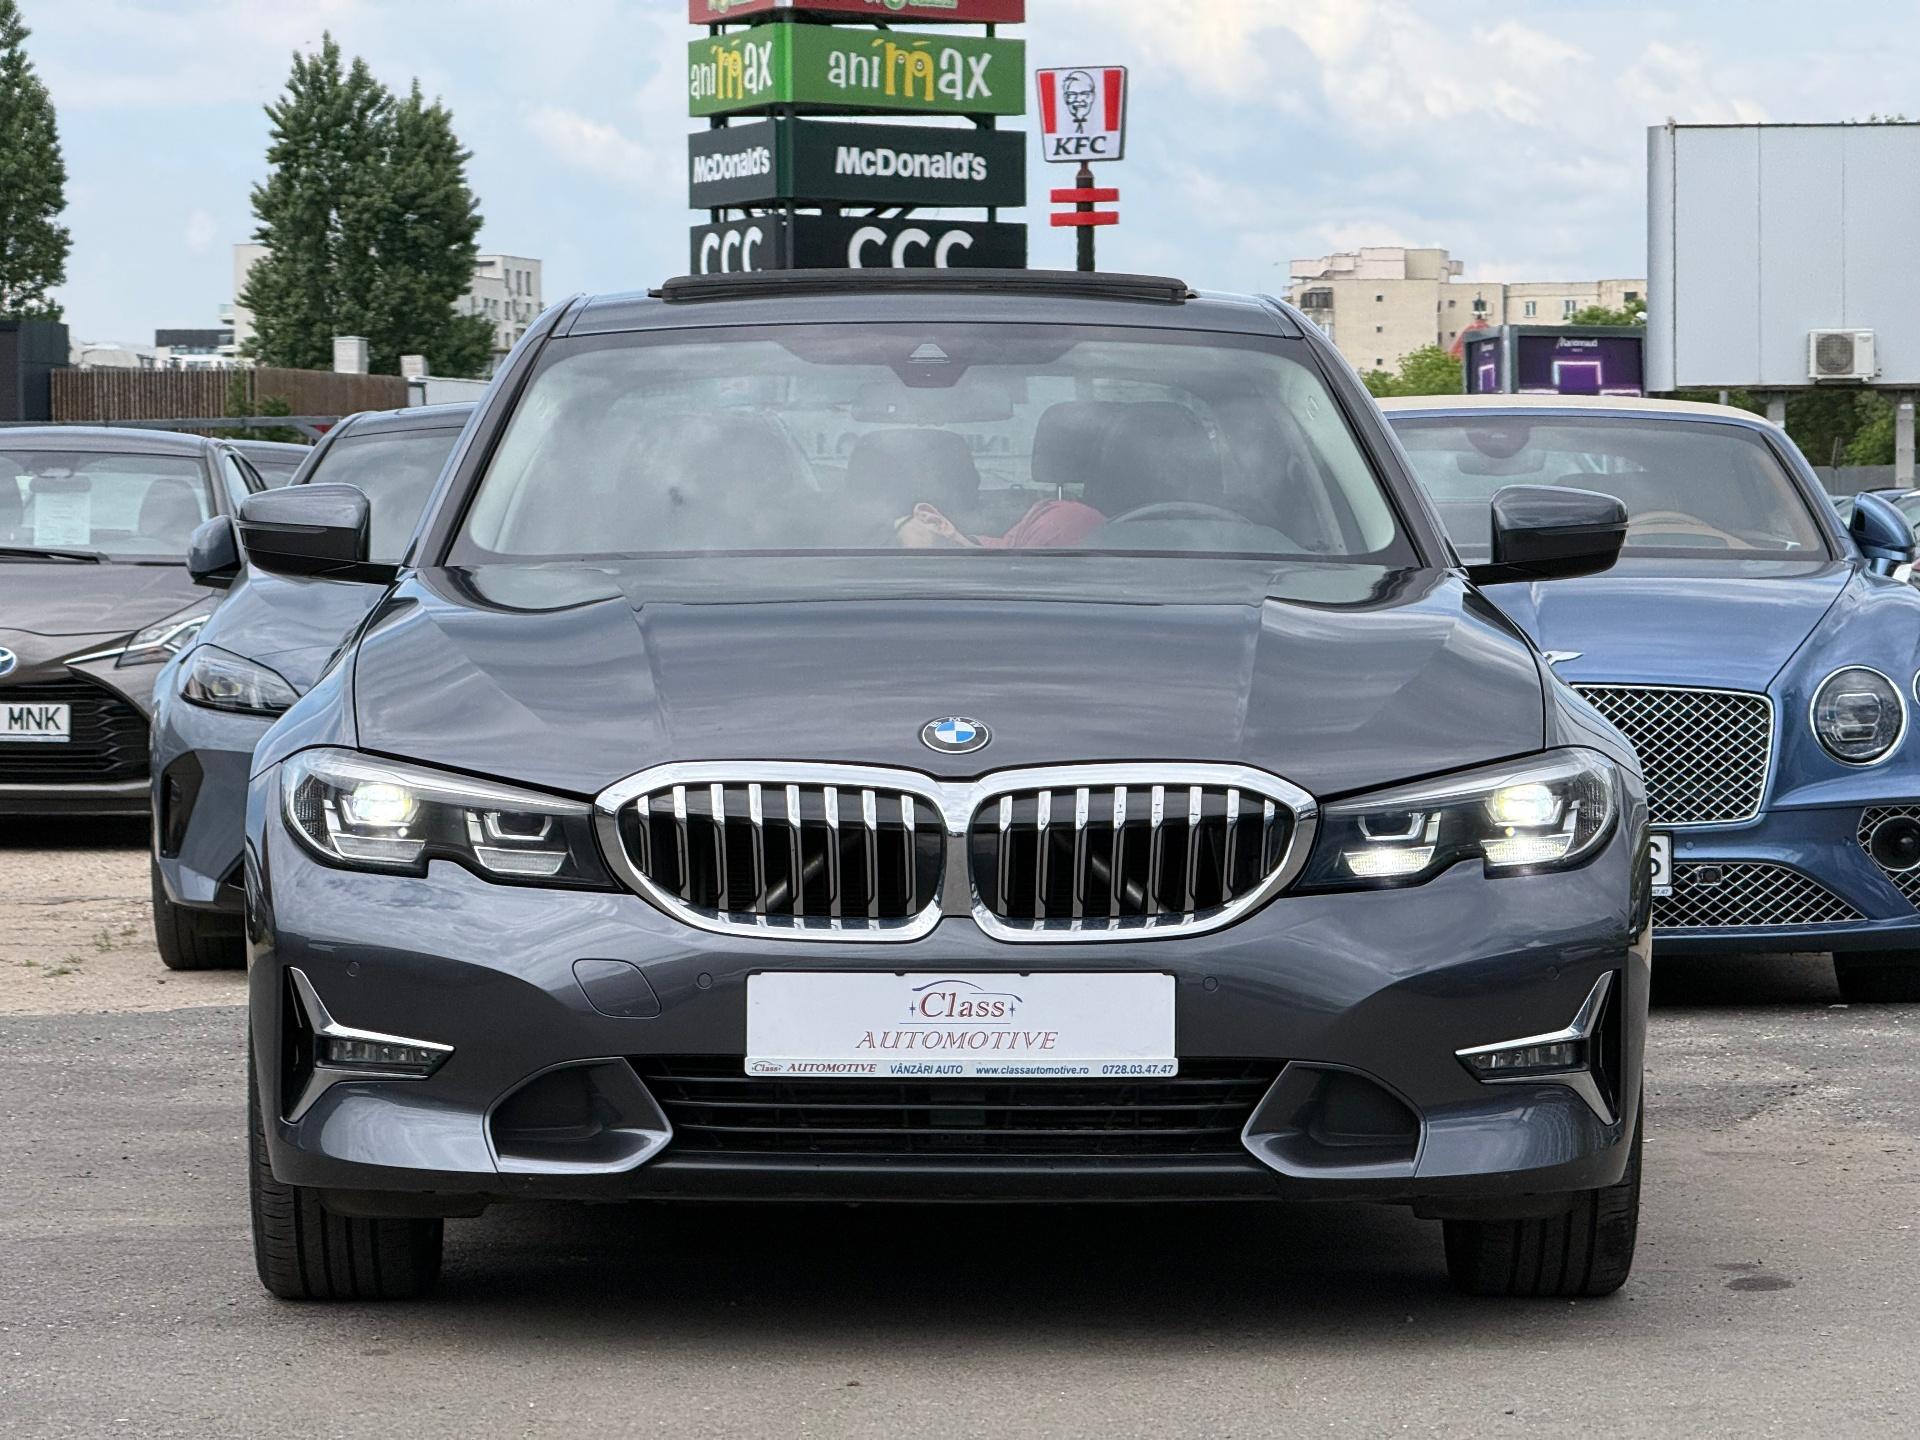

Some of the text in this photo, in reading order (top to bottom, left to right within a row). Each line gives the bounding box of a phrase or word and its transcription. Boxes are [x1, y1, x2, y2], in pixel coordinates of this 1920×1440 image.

[1053, 136, 1107, 156] KFC
[693, 146, 771, 184] McDonald's
[835, 146, 987, 181] McDonald's
[8, 706, 61, 730] MNK
[918, 992, 1006, 1018] Class
[855, 1030, 1059, 1050] AUTOMOTIVE
[754, 1063, 778, 1073] Class
[787, 1063, 878, 1073] AUTOMOTIVE
[935, 1065, 964, 1075] AUTO
[976, 1065, 1090, 1075] www.classautomotive.ro
[1102, 1064, 1174, 1075] 0728.03.47.47
